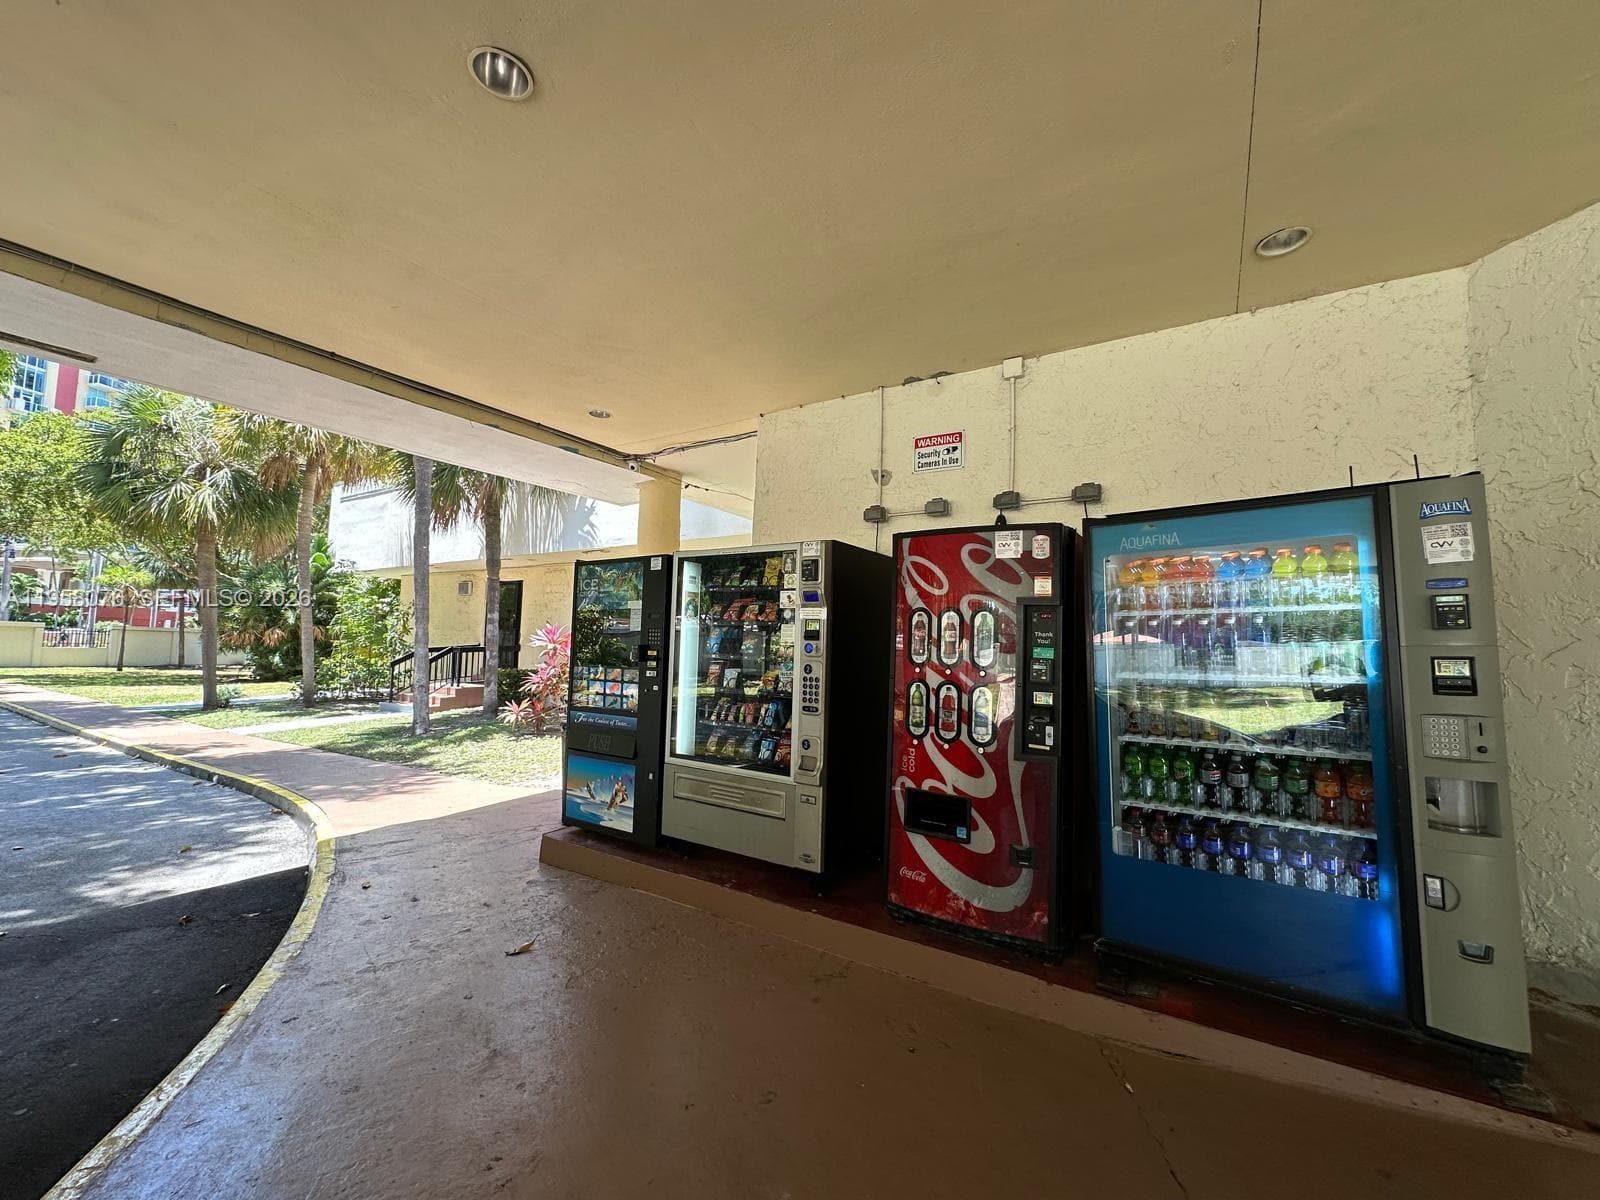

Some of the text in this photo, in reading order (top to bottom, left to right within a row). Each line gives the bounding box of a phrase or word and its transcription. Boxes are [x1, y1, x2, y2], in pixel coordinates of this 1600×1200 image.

[917, 434, 960, 447] WARNING
[917, 449, 940, 460] Security
[917, 456, 959, 469] Cameras In Use
[1420, 499, 1471, 517] AQUAFINA
[1120, 531, 1182, 551] AQUAFINA
